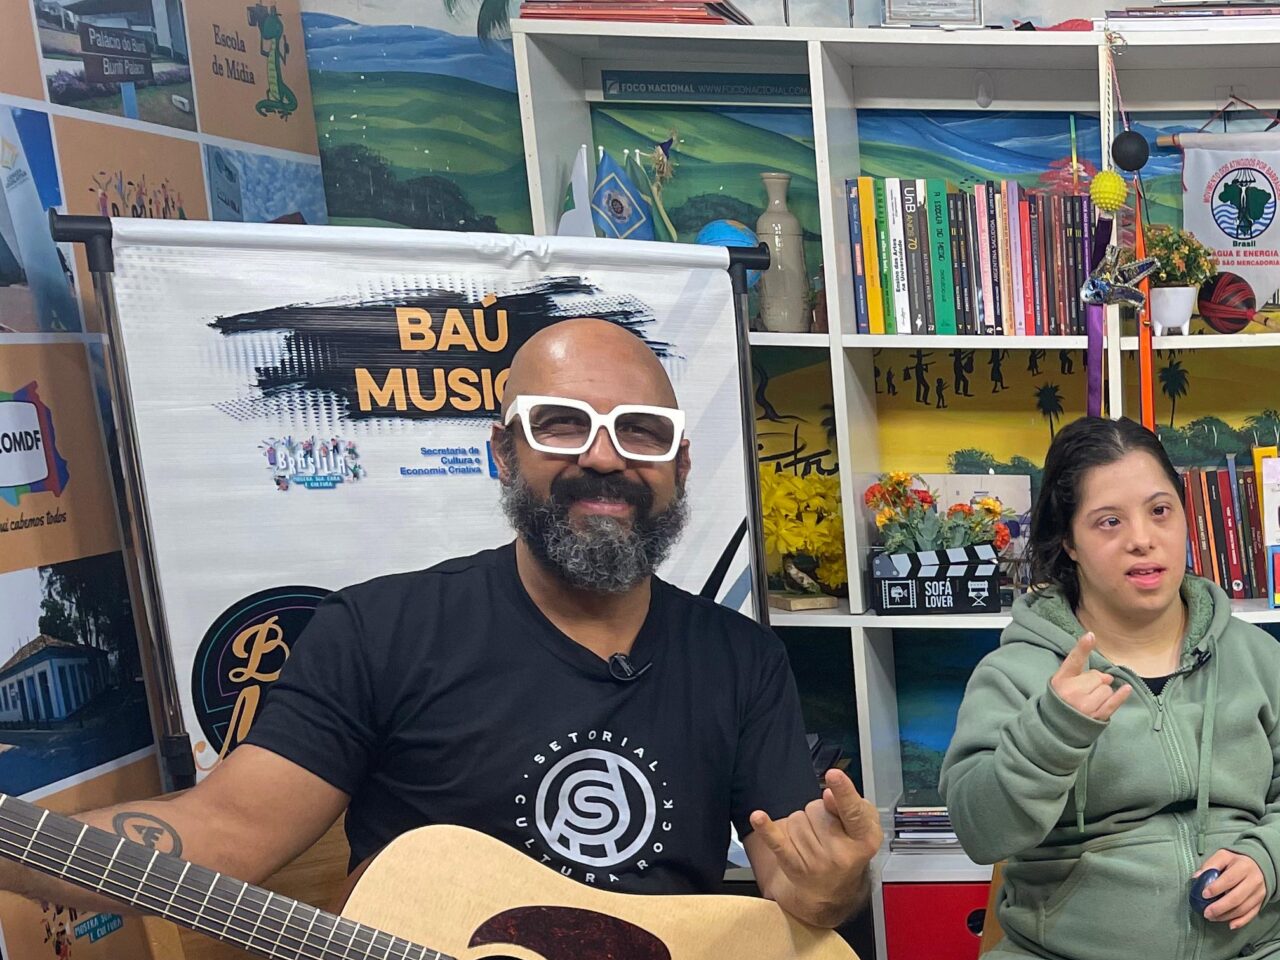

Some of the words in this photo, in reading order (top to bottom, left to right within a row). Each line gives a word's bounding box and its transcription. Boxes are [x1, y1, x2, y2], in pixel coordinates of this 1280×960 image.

[213, 24, 247, 53] Escola
[212, 55, 224, 76] de
[225, 58, 256, 85] Mídia
[621, 82, 647, 93] FOCO
[648, 82, 695, 94] NACIONAL
[904, 187, 916, 213] UnB
[907, 237, 918, 250] 70
[991, 250, 999, 282] ARGENTINA
[395, 295, 509, 352] BAÚ
[0, 430, 41, 454] OMDF
[420, 447, 465, 456] Secretaria
[400, 466, 447, 477] Economia
[448, 465, 482, 476] Criativa
[440, 456, 471, 466] Cultura
[10, 511, 45, 531] cabemos
[46, 506, 67, 526] todos
[925, 577, 952, 596] SOFÁ
[925, 595, 954, 608] LOVER
[533, 730, 658, 772] SETORIAL
[636, 799, 674, 871] ROCK
